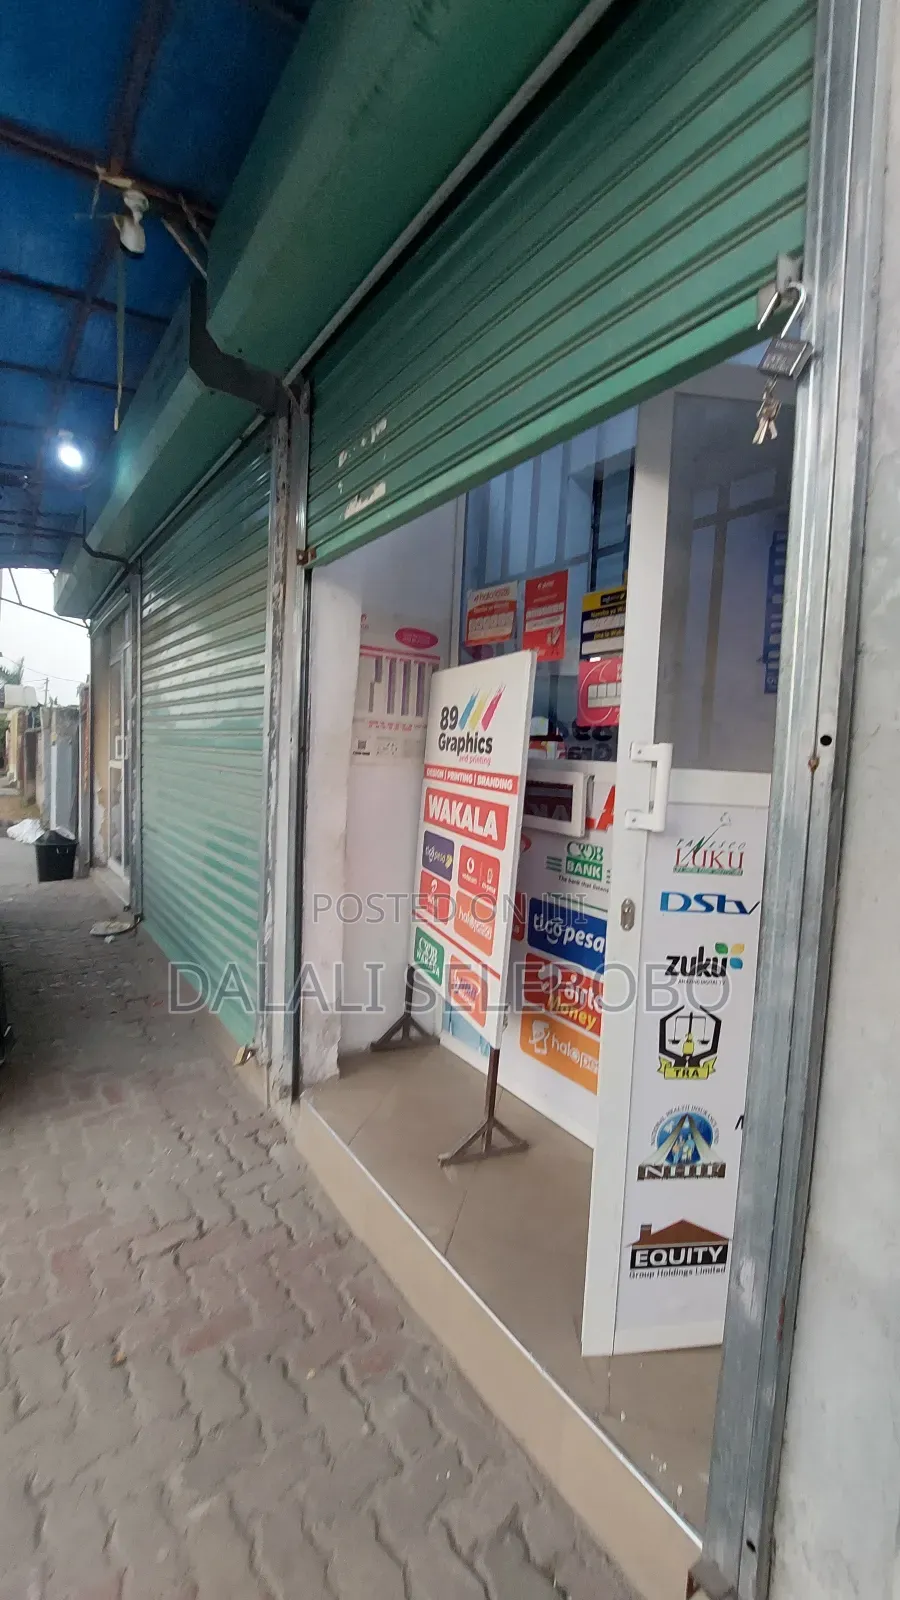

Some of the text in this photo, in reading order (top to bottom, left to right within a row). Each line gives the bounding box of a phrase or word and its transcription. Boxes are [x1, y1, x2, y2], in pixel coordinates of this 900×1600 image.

[439, 706, 459, 731] 89
[438, 732, 493, 756] Graphics
[426, 767, 513, 791] DESIGN PRINTING BRANDING
[428, 794, 498, 841] WAKALA
[567, 860, 601, 879] BANK
[675, 847, 744, 868] LUKU
[665, 946, 728, 977] zuku
[564, 973, 604, 1011] airte
[548, 994, 598, 1030] Money
[673, 1067, 700, 1078] TRA
[635, 1246, 723, 1267] EQUITY
[629, 1264, 726, 1280] Group Holdings Limited
